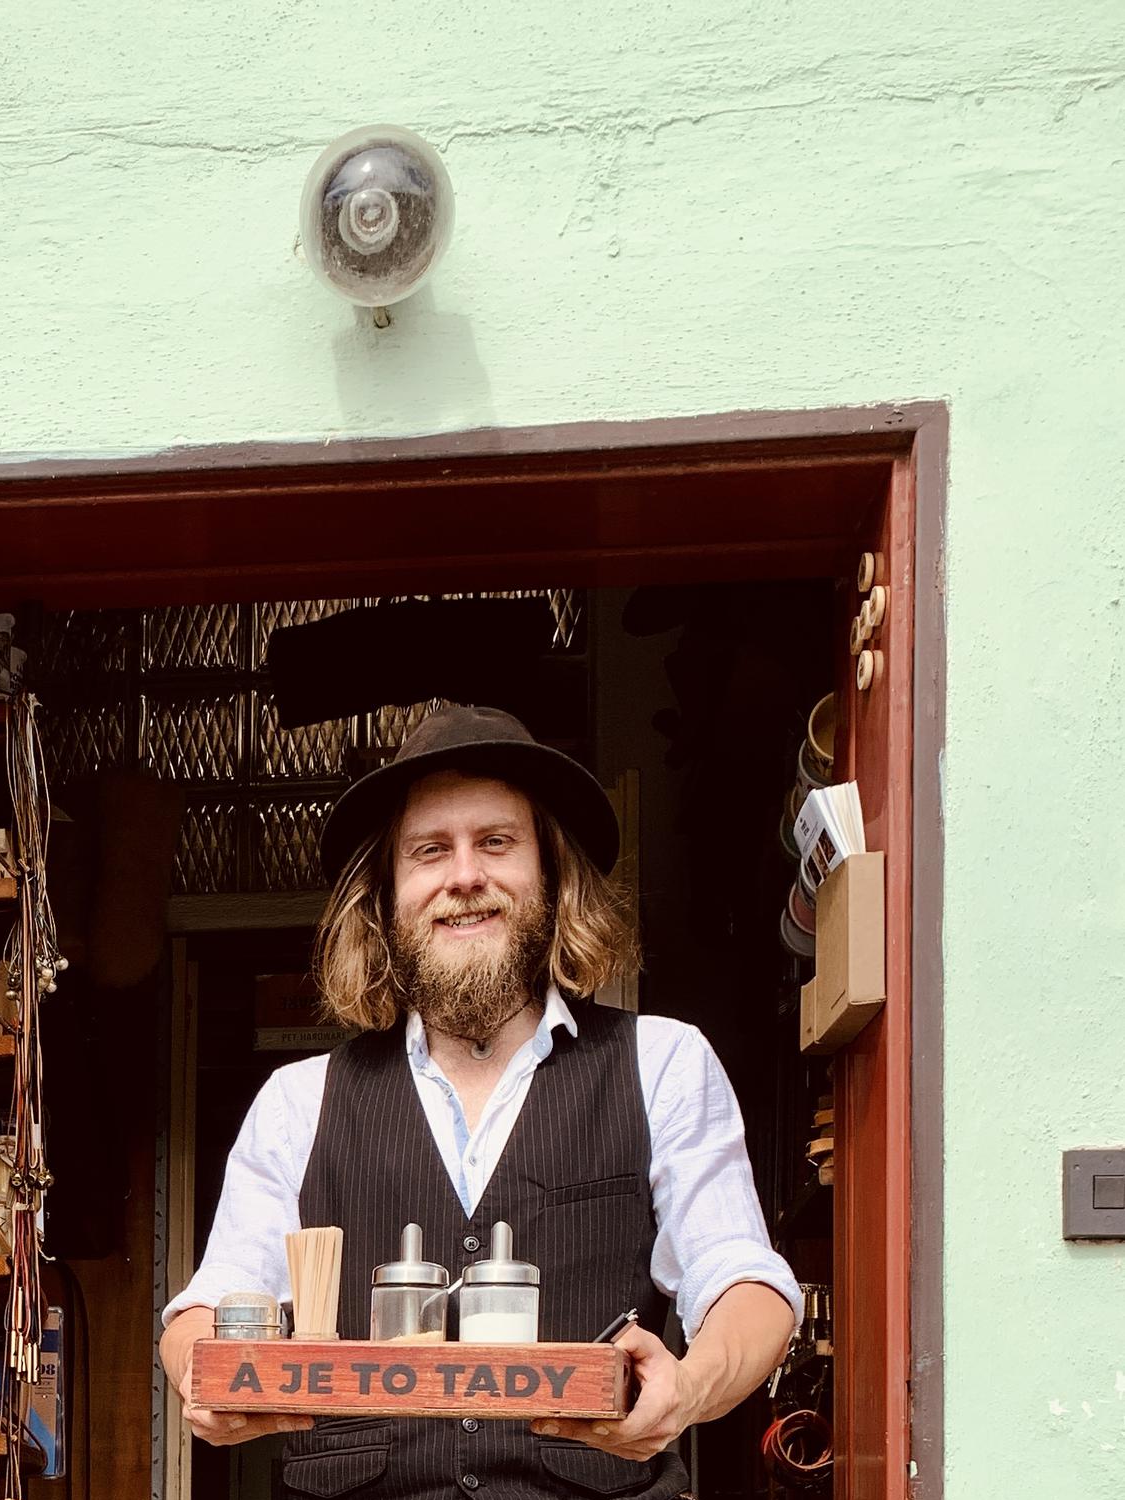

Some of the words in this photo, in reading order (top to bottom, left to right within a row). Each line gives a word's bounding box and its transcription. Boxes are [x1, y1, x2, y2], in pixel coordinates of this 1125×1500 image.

[229, 1363, 263, 1393] A
[279, 1363, 331, 1395] JE
[351, 1363, 417, 1395] TO
[435, 1364, 576, 1399] TADY
